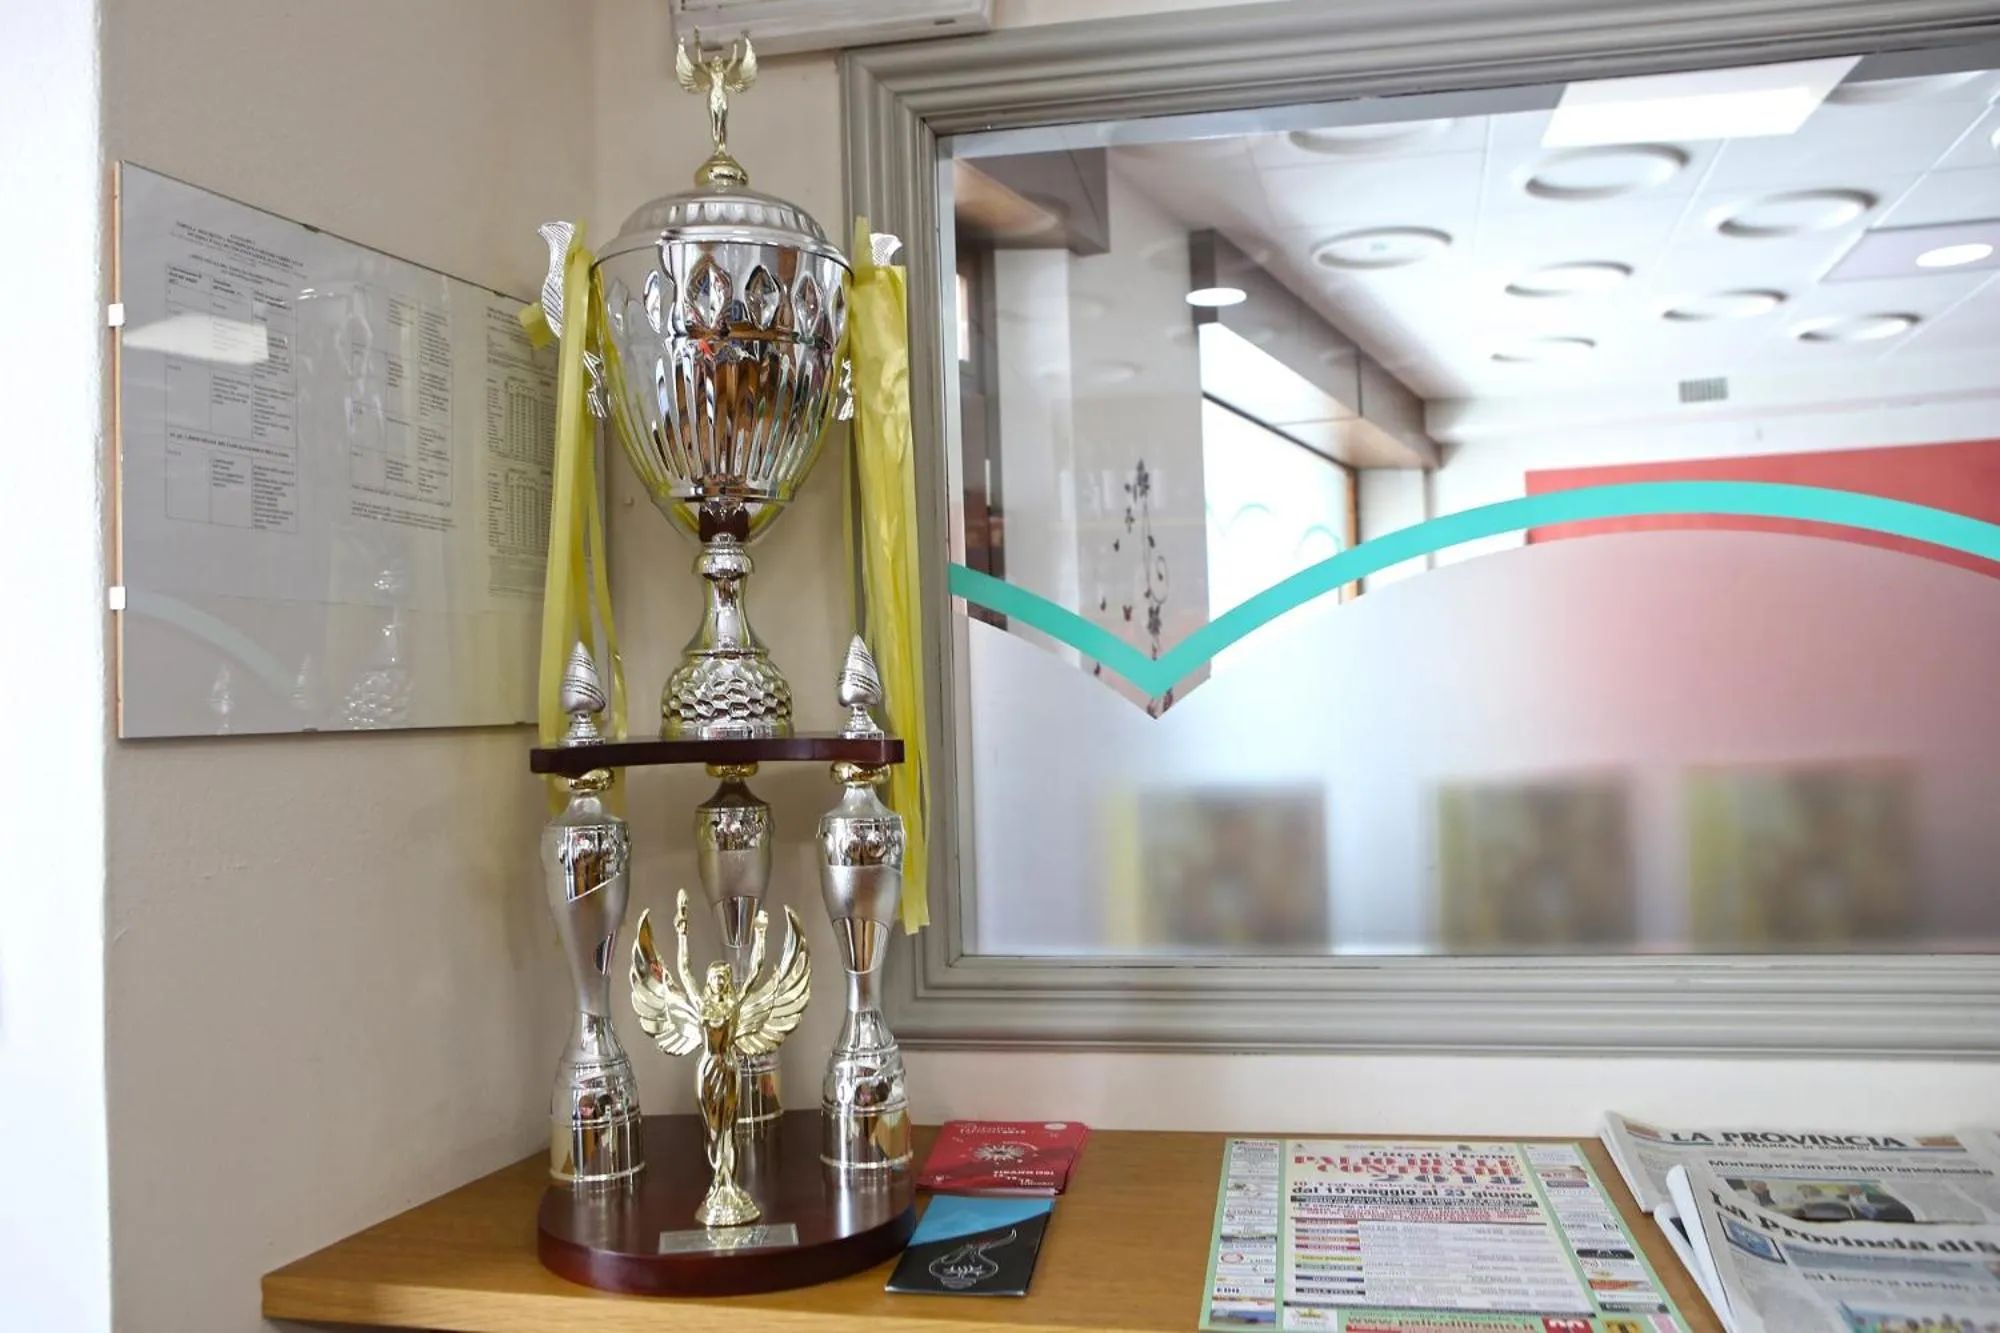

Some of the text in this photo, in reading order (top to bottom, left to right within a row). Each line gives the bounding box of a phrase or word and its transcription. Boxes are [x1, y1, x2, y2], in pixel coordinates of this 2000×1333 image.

[1670, 1131, 1907, 1148] LA PROVINCIA
[1352, 1188, 1416, 1198] maggio
[1422, 1188, 1439, 1196] al
[1471, 1190, 1533, 1201] giugno
[1757, 1214, 1931, 1252] Provincia
[1937, 1238, 1973, 1254] di
